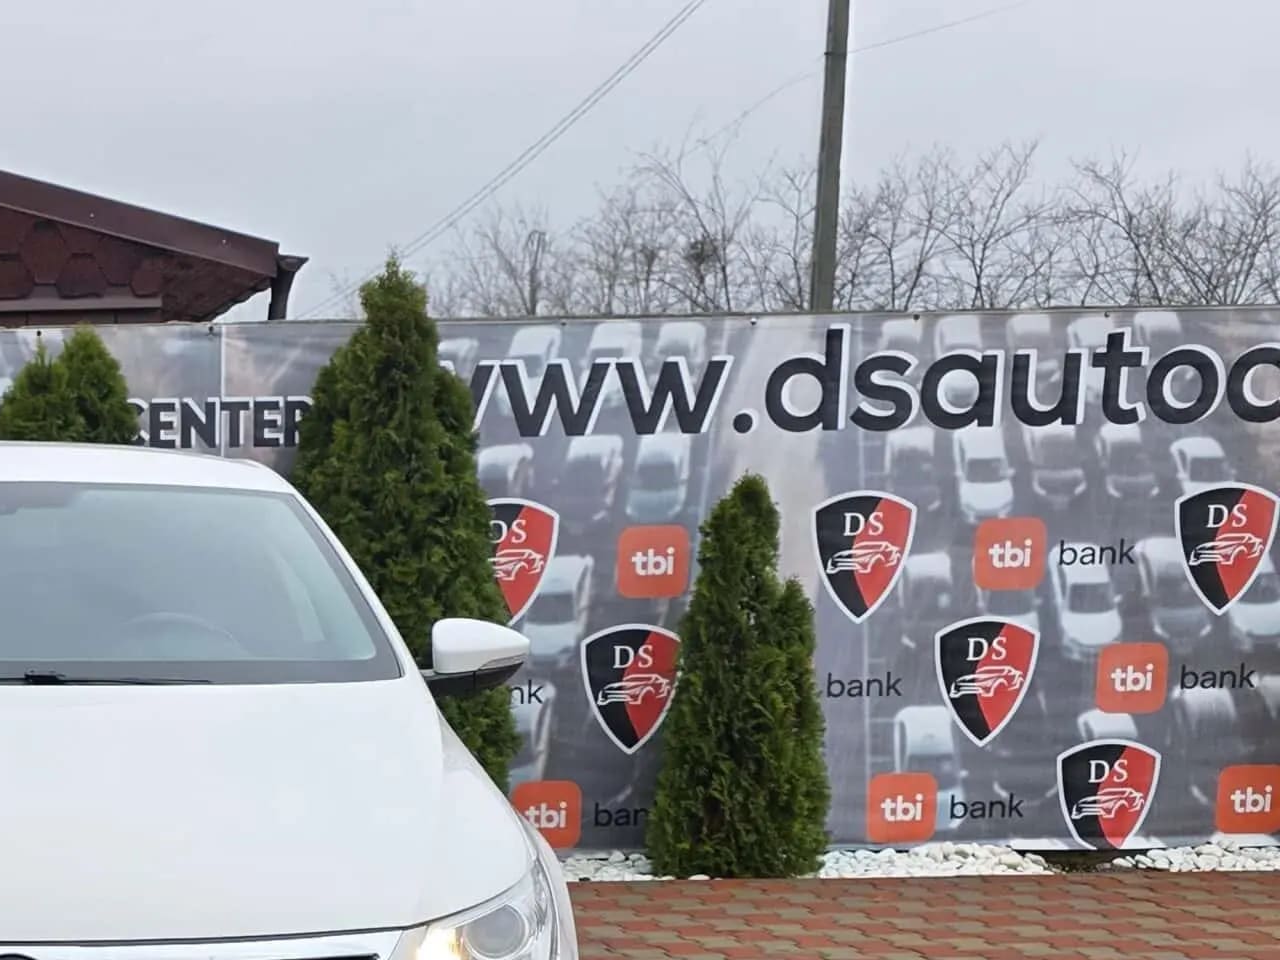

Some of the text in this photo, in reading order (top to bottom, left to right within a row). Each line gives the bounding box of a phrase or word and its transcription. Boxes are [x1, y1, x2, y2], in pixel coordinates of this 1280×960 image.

[464, 323, 1280, 438] ww.dsautoc
[843, 512, 884, 537] DS
[1206, 504, 1248, 528] DS
[631, 546, 676, 577] tbi
[988, 538, 1136, 569] tbi bank
[613, 644, 654, 669] DS
[966, 637, 1007, 662] DS
[826, 672, 903, 698] bank
[1110, 662, 1257, 692] tbi bank
[1088, 759, 1129, 784] DS
[880, 792, 1025, 822] tbi bank
[1230, 785, 1273, 814] tbi
[524, 801, 650, 829] tbi ban
